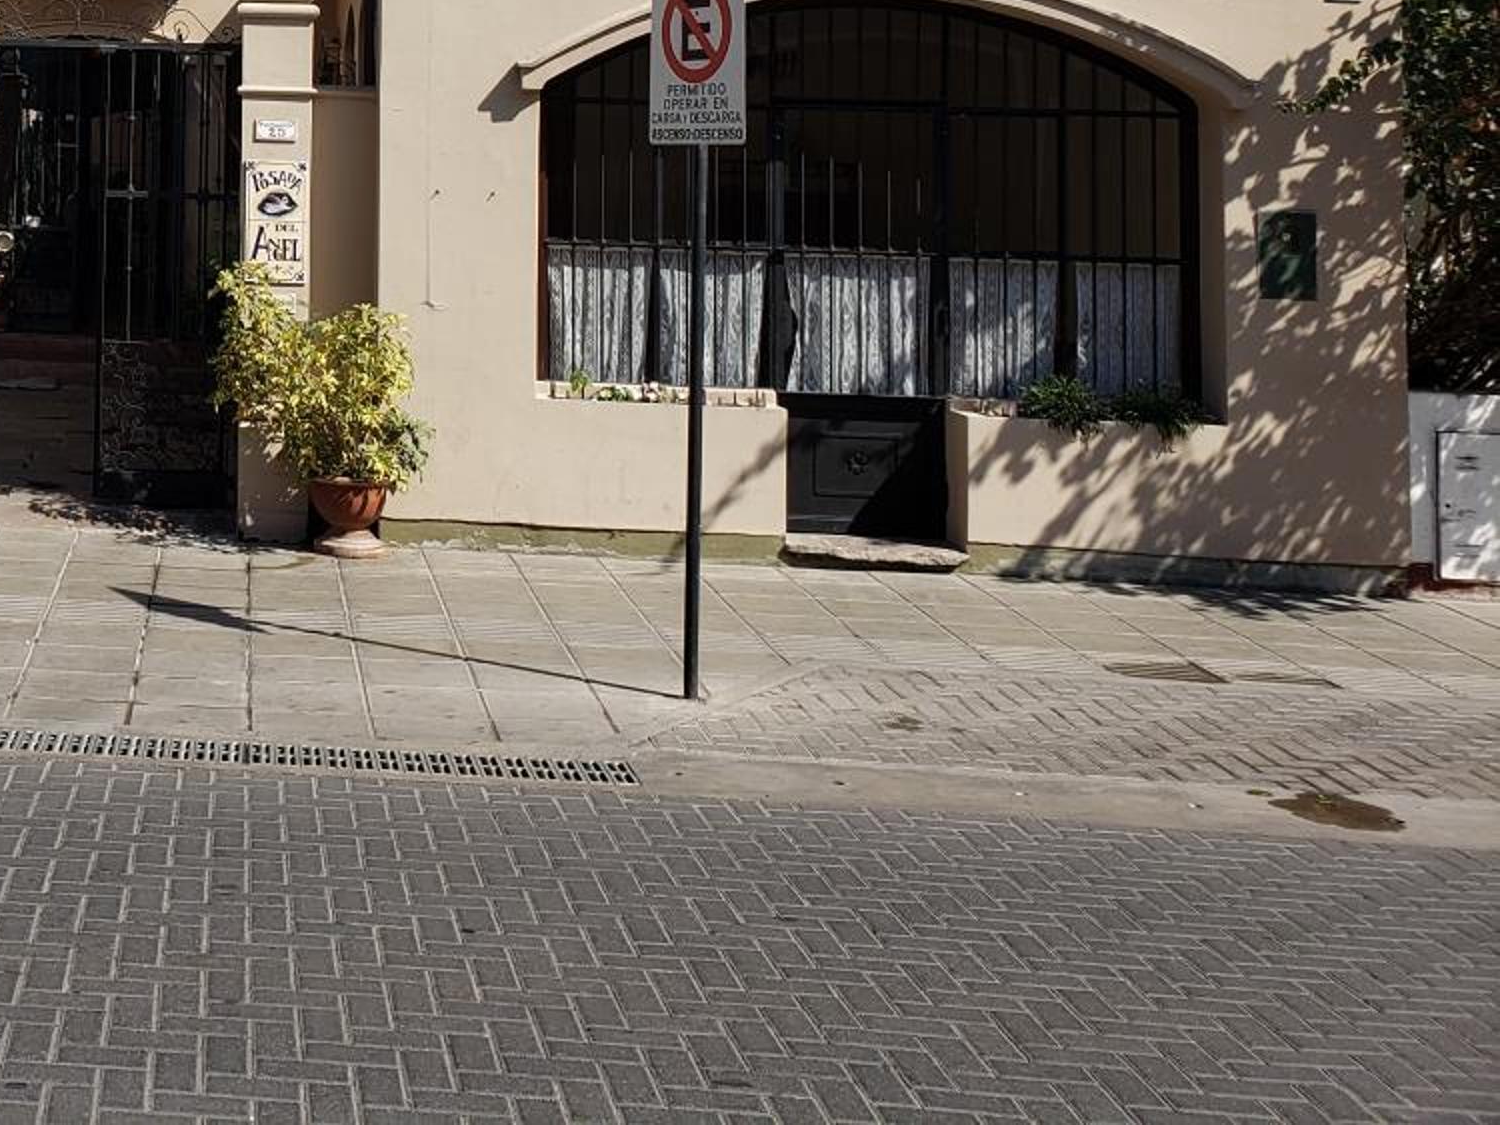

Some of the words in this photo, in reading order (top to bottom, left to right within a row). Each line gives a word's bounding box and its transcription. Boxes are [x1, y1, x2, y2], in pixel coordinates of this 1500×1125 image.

[663, 98, 707, 110] OPERAR
[713, 96, 729, 109] EN
[689, 110, 742, 124] DESCARGA
